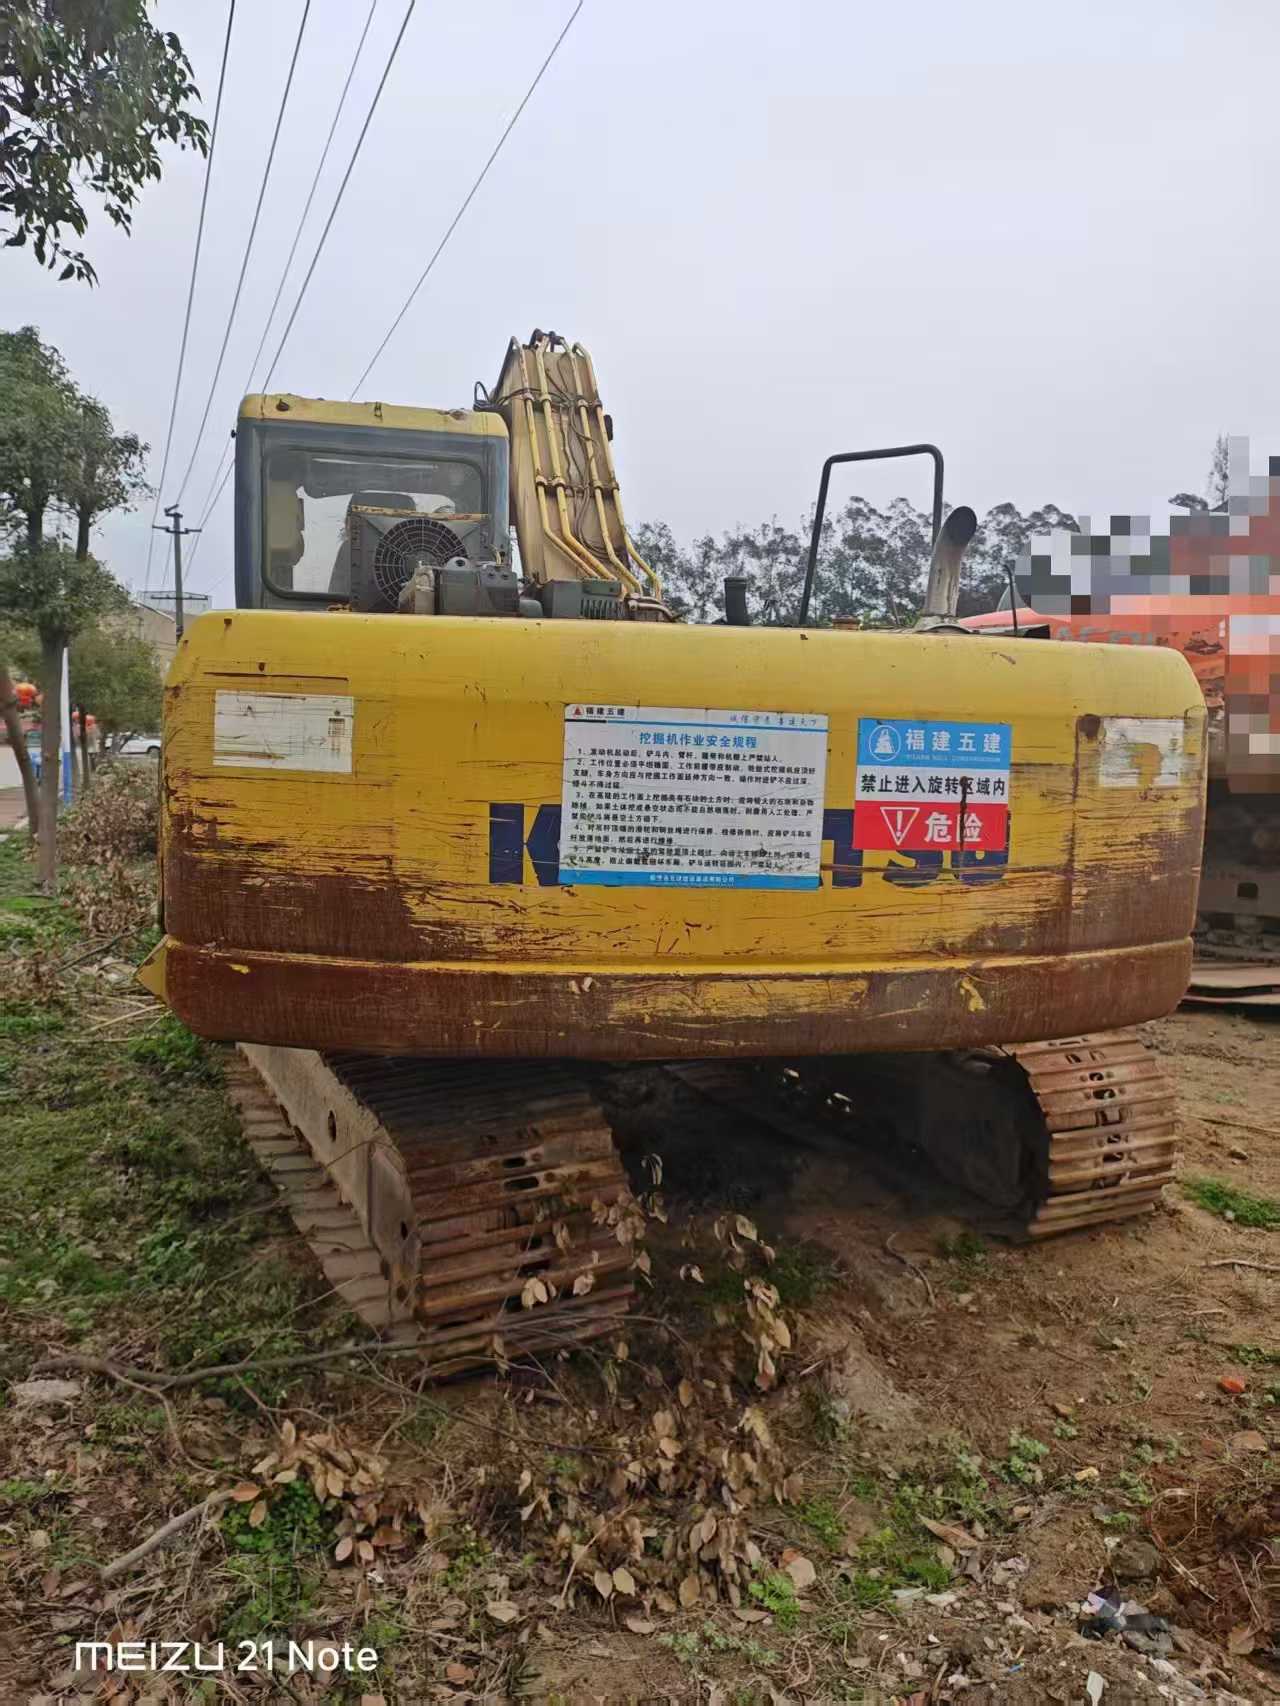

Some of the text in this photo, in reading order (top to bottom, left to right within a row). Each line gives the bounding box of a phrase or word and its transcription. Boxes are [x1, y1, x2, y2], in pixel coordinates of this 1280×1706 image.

[638, 731, 758, 749] 挖掘机作业安全规程
[906, 728, 1001, 754] 福建五建
[861, 774, 1005, 796] 禁止进入旋转区域内
[924, 811, 983, 843] 危险
